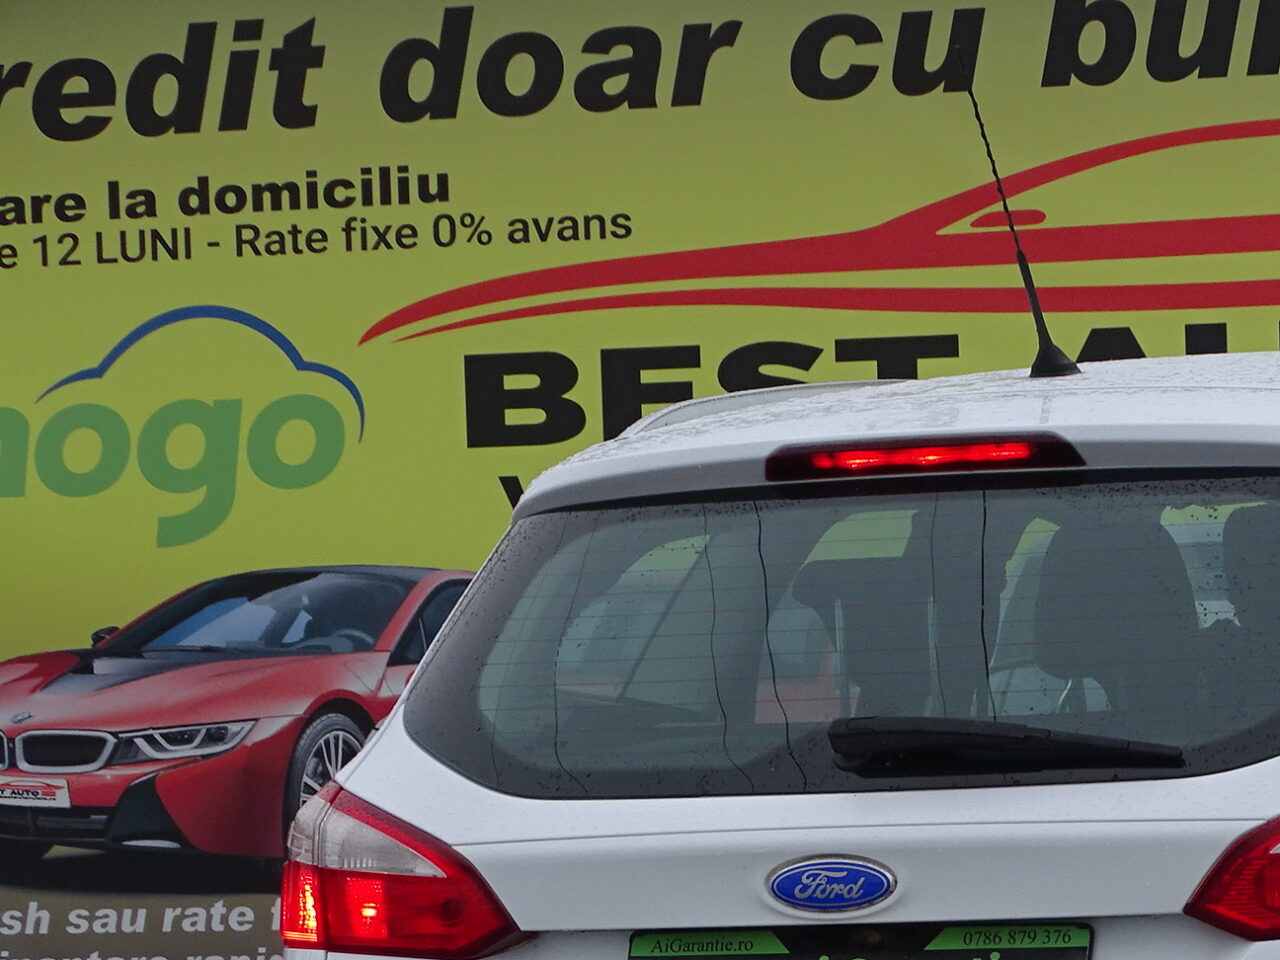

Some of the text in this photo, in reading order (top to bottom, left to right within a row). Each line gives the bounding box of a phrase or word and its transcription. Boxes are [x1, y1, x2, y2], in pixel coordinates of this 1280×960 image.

[379, 6, 743, 122] doar
[789, 8, 986, 102] cu
[0, 165, 450, 226] are la domiciliu
[32, 232, 82, 267] 12
[95, 227, 192, 264] LUNI
[235, 223, 329, 257] Rate
[341, 216, 419, 252] fixe
[433, 212, 493, 248] 0%
[507, 212, 633, 244] avans
[793, 869, 866, 899] Ford
[0, 901, 50, 935] sh
[65, 907, 147, 935] sau
[162, 900, 255, 933] rate
[650, 938, 754, 954] AiGarantie.ro
[963, 928, 1072, 946] 0786 879 376
